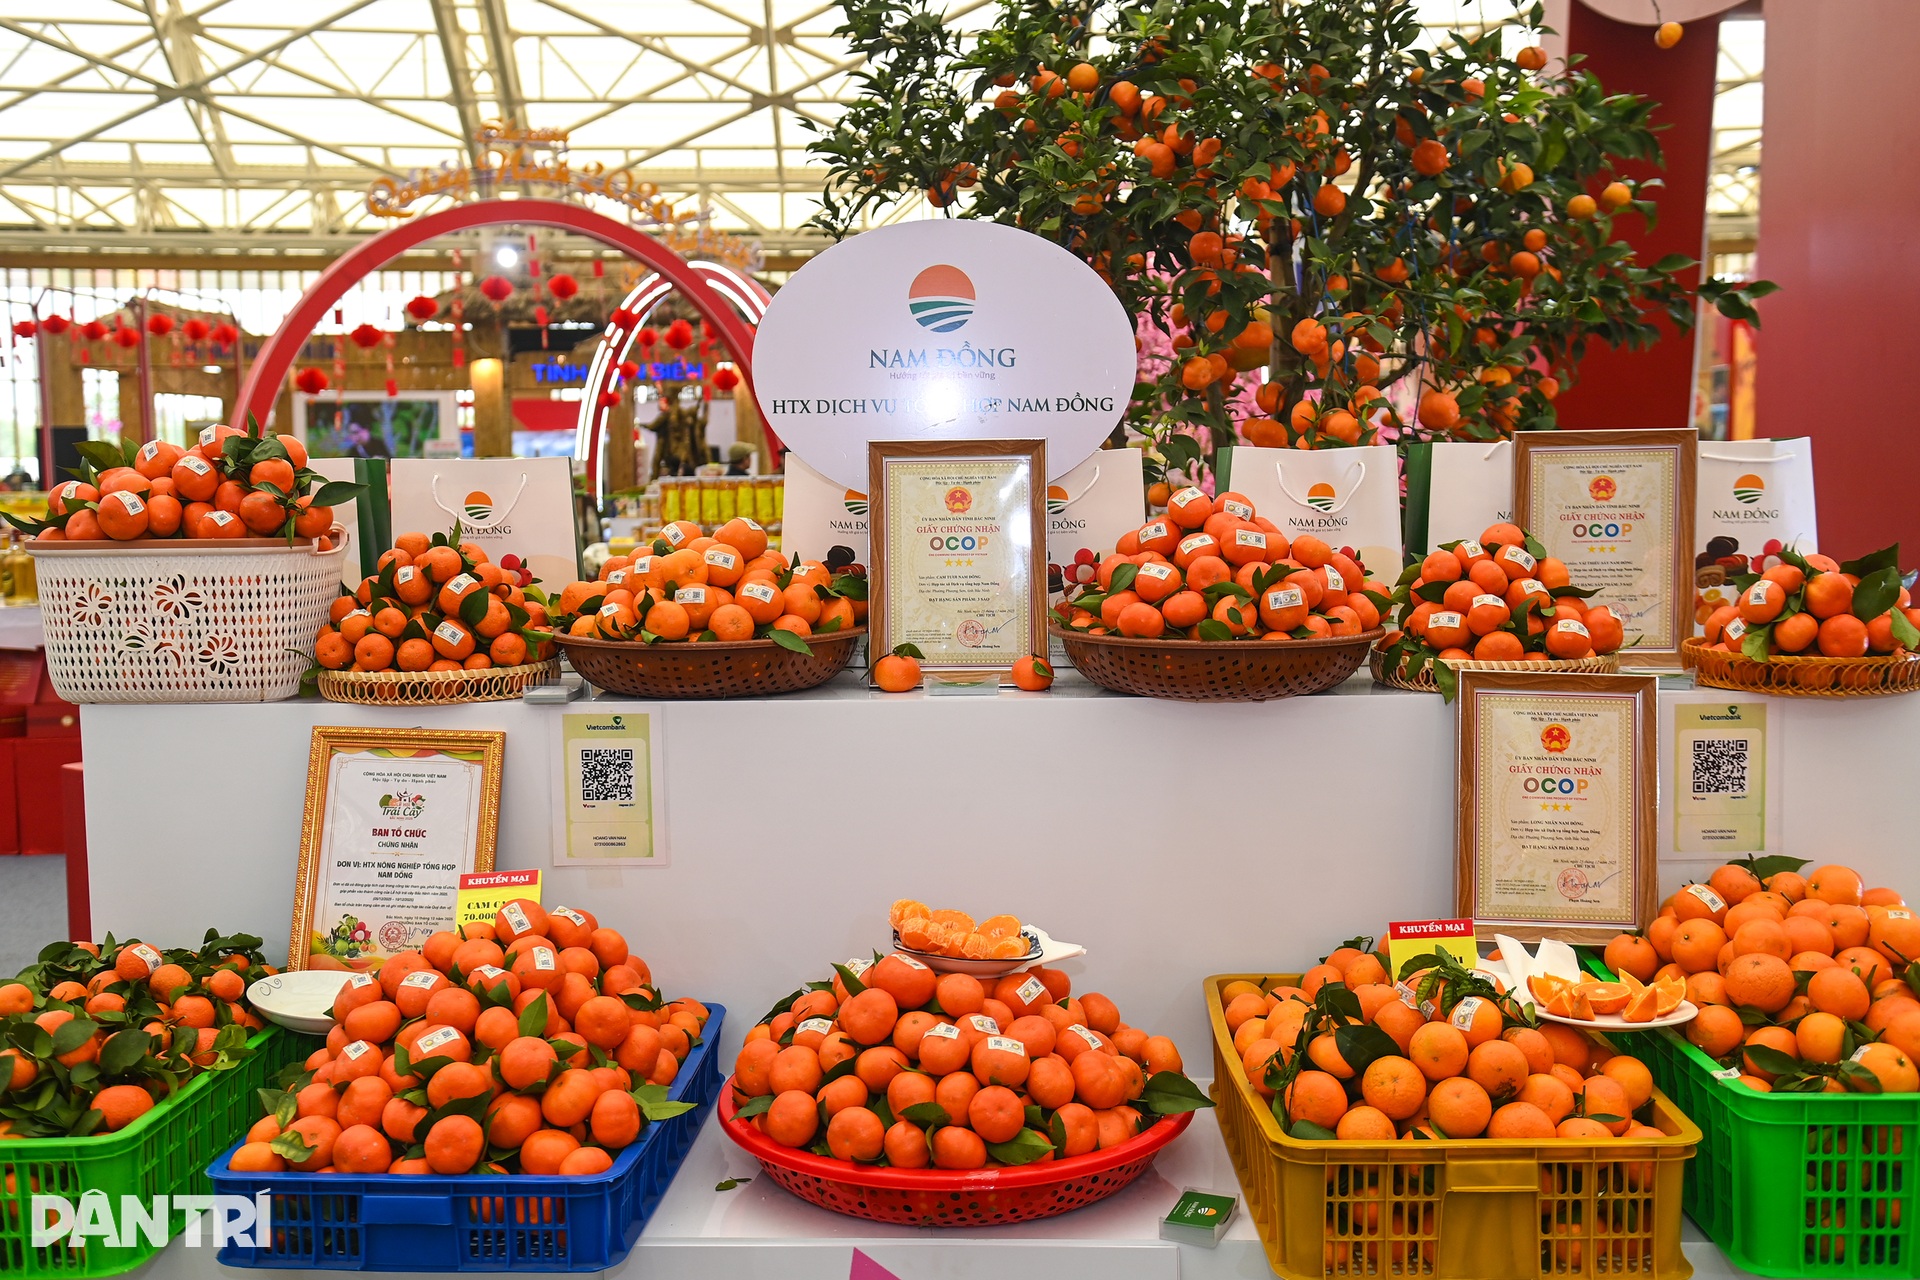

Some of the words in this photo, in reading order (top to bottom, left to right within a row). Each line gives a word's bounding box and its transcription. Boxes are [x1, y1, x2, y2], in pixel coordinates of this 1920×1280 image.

[869, 349, 930, 369] NAM
[936, 341, 1016, 368] ĐỒNG
[531, 355, 588, 382] TỈNH
[890, 371, 917, 380] Hướng
[772, 400, 811, 414] HTX
[816, 399, 866, 416] DỊCH
[871, 399, 897, 416] VỤ
[1007, 397, 1051, 412] NAM
[1056, 392, 1113, 412] ĐỒNG
[1559, 511, 1582, 521] GIẤY
[1583, 511, 1617, 521] CHỨNG
[1618, 510, 1645, 522] NHẬN
[1712, 509, 1740, 519] NAM
[830, 520, 853, 530] NAM
[1288, 516, 1315, 527] NAM
[916, 524, 938, 534] GIẤY
[940, 524, 973, 533] CHỨNG
[975, 523, 1001, 534] NHẬN
[1572, 523, 1633, 538] OCOP
[929, 536, 989, 551] OCOP
[1509, 762, 1534, 774] GIẤY
[1536, 764, 1571, 775] CHỨNG
[1573, 765, 1602, 776] NHẬN
[1523, 777, 1589, 794] OCOP
[382, 806, 401, 816] Trái
[402, 806, 422, 819] Cây
[372, 828, 389, 837] BAN
[391, 826, 402, 837] TỔ
[404, 827, 427, 838] CHỨC
[378, 840, 399, 848] CHỨNG
[400, 841, 418, 849] NHẬN
[377, 861, 396, 869] NÔNG
[468, 874, 509, 886] KHUYẾN
[510, 875, 530, 883] MẠI
[467, 901, 490, 910] CAM
[1399, 922, 1442, 934] KHUYẾN
[1445, 923, 1465, 933] MẠI
